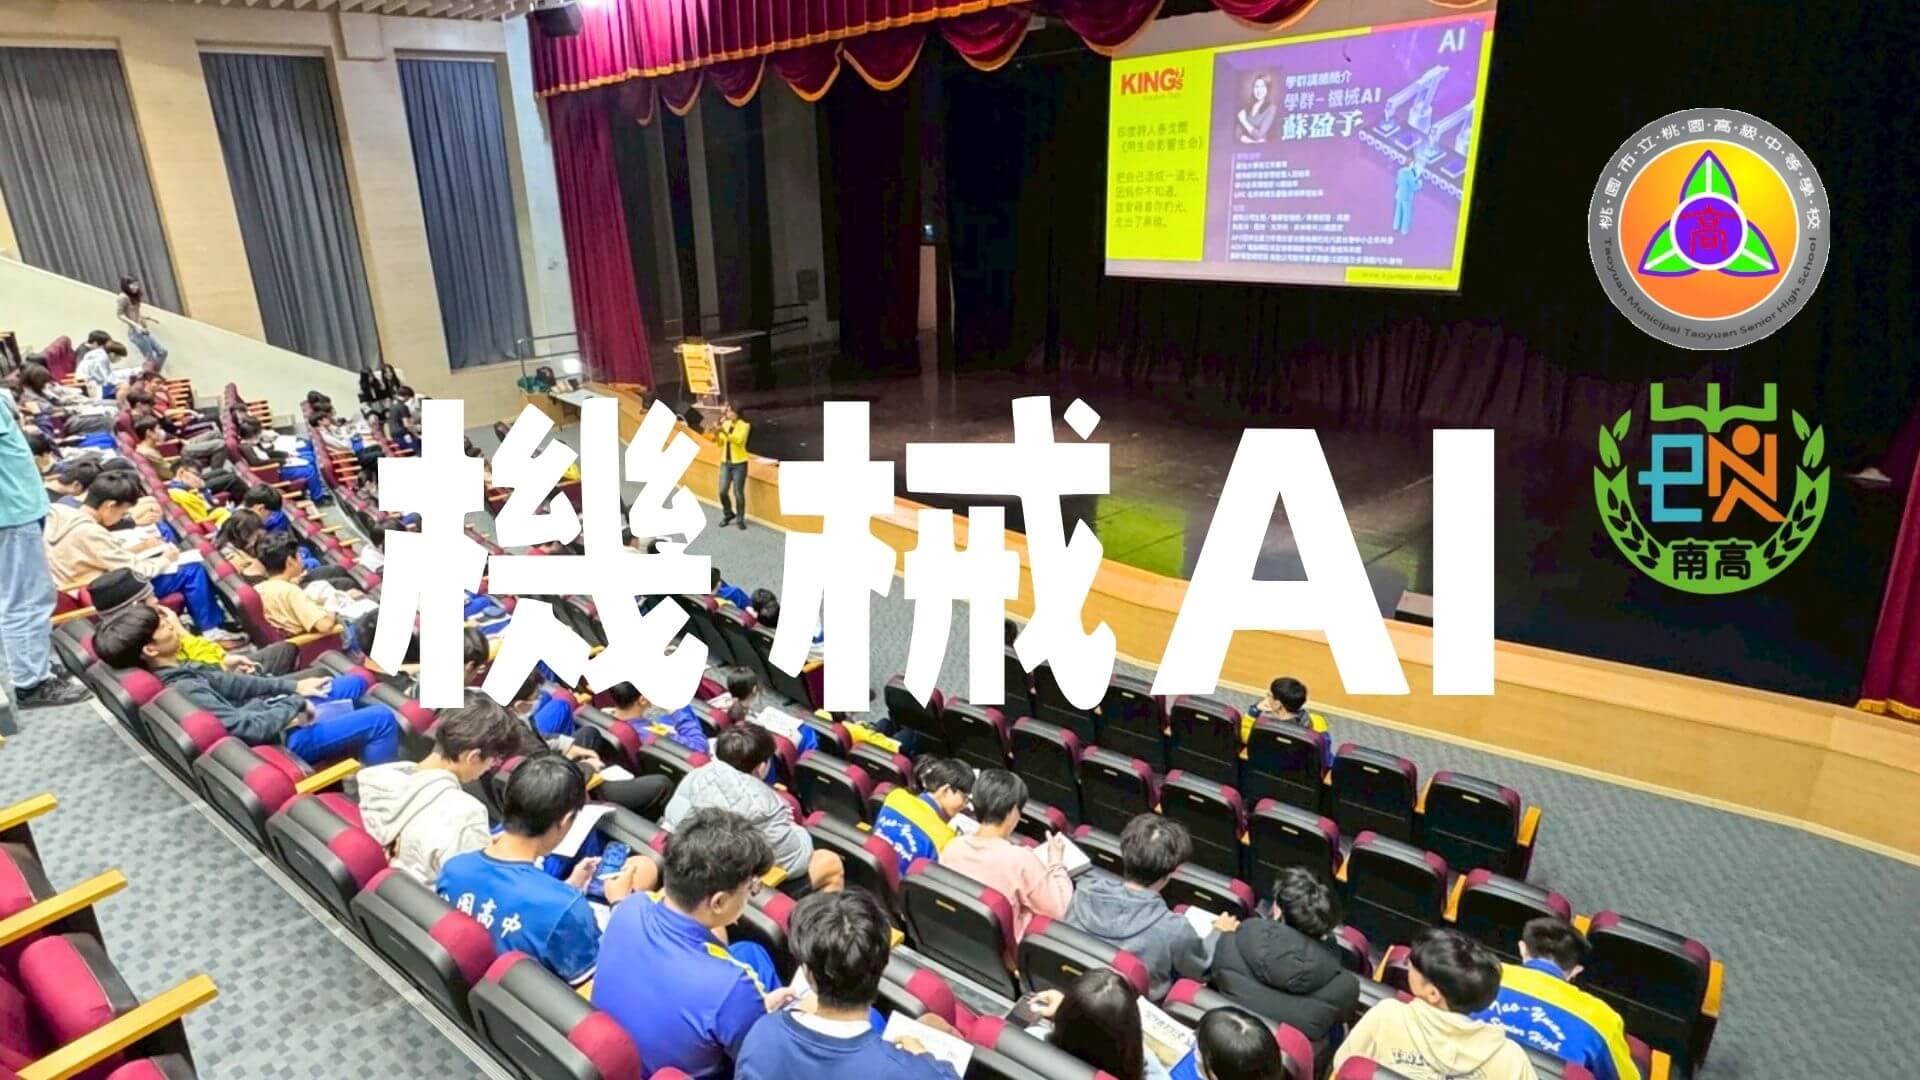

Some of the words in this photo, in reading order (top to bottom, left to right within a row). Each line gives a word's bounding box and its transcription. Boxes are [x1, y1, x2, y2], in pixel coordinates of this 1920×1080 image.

[1438, 28, 1466, 54] AI
[440, 892, 522, 938] 園高中
